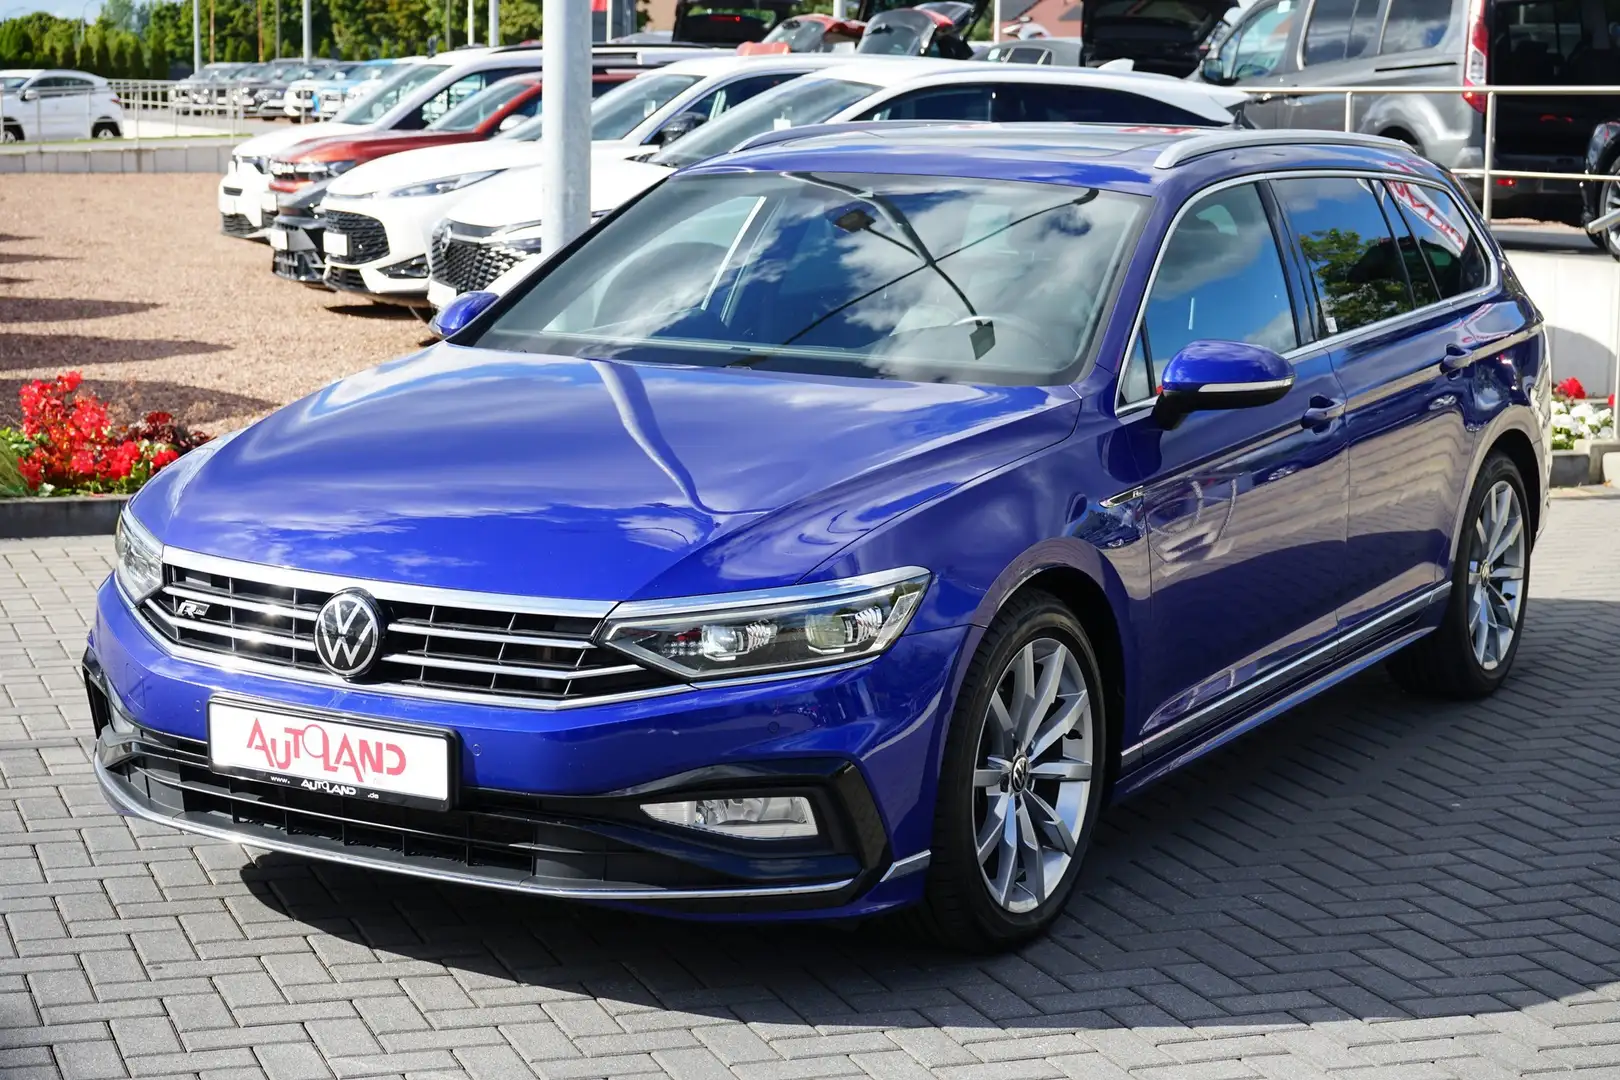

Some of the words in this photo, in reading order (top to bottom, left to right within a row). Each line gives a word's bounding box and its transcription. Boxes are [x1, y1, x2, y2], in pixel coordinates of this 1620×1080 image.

[318, 598, 376, 670] VW
[270, 775, 291, 785] www.
[301, 779, 357, 796] AUTOLAND
